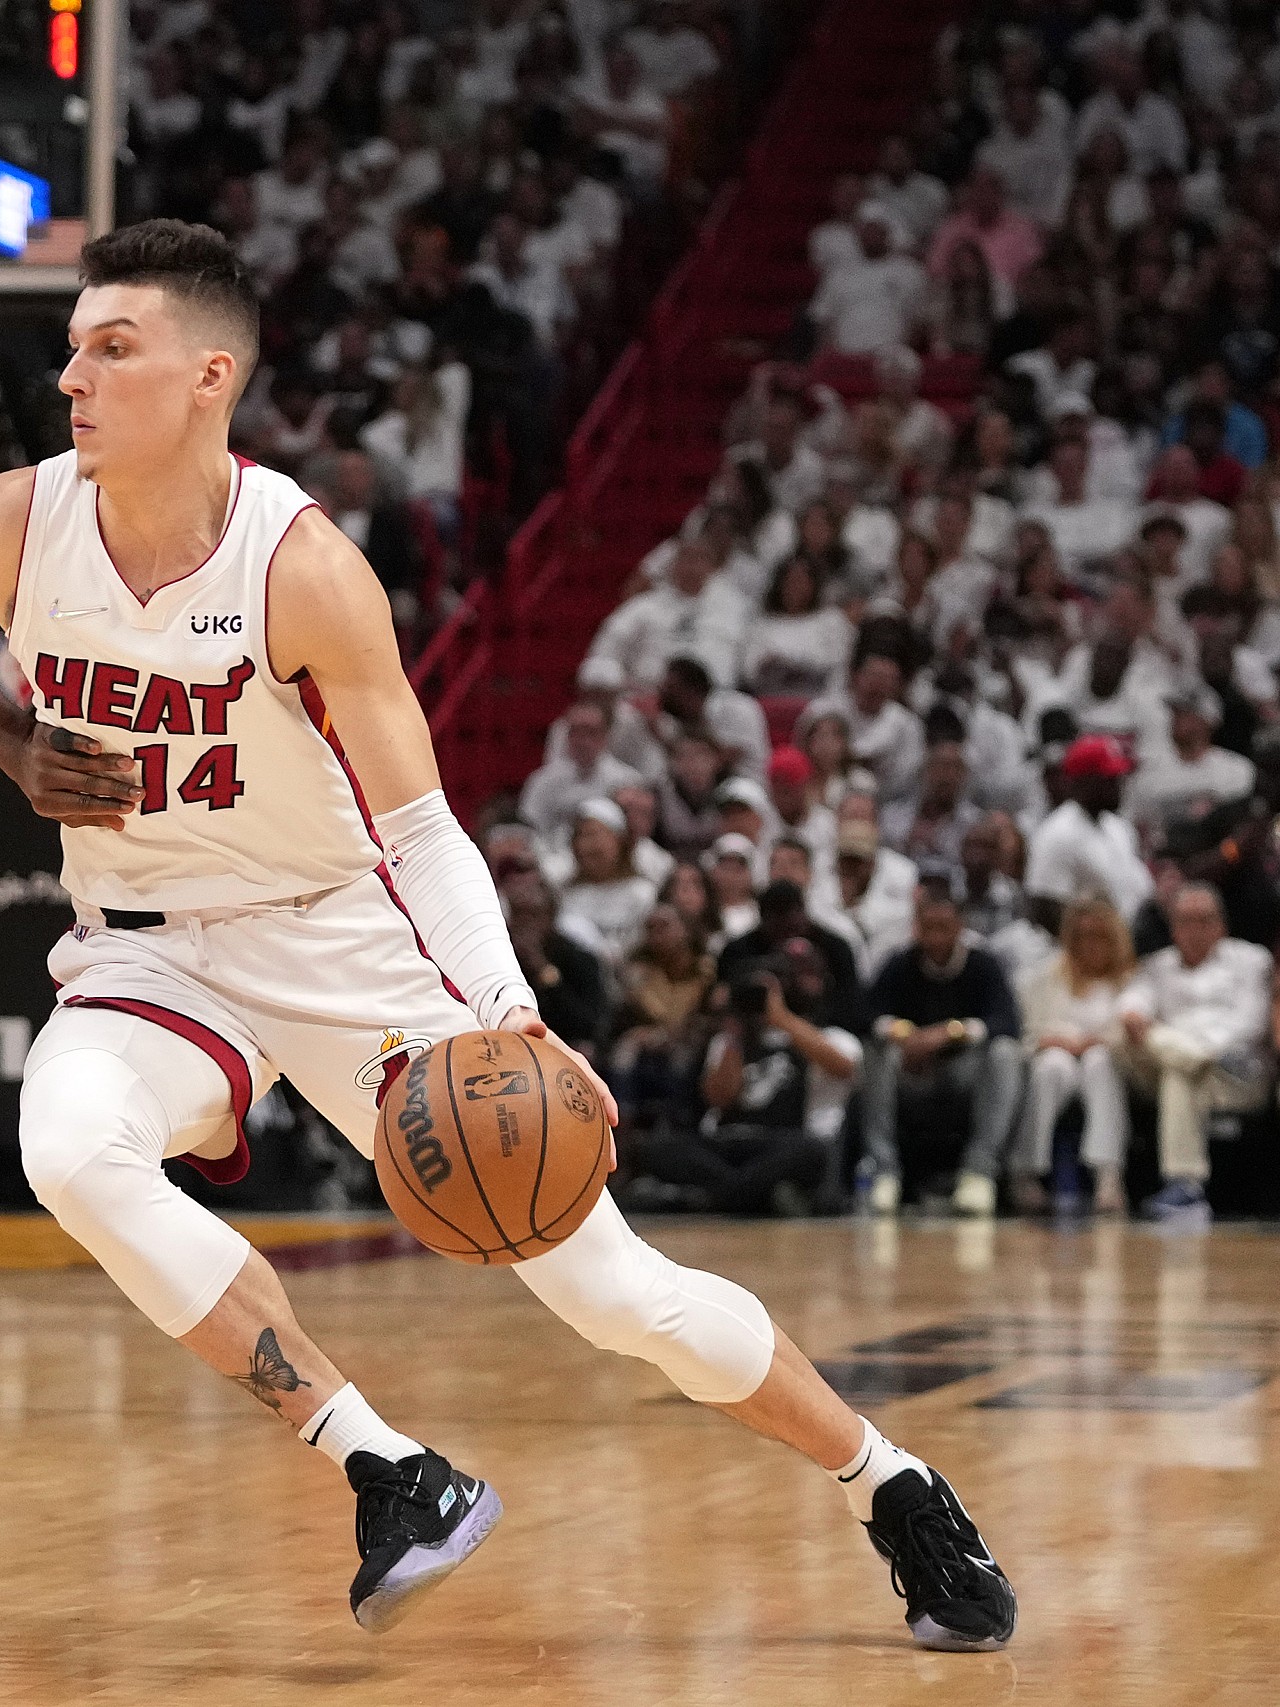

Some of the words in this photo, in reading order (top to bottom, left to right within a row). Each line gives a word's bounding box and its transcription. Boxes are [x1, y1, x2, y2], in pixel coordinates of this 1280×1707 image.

[34, 652, 256, 736] HEAT
[133, 743, 245, 815] 14
[398, 1048, 454, 1196] Wilson
